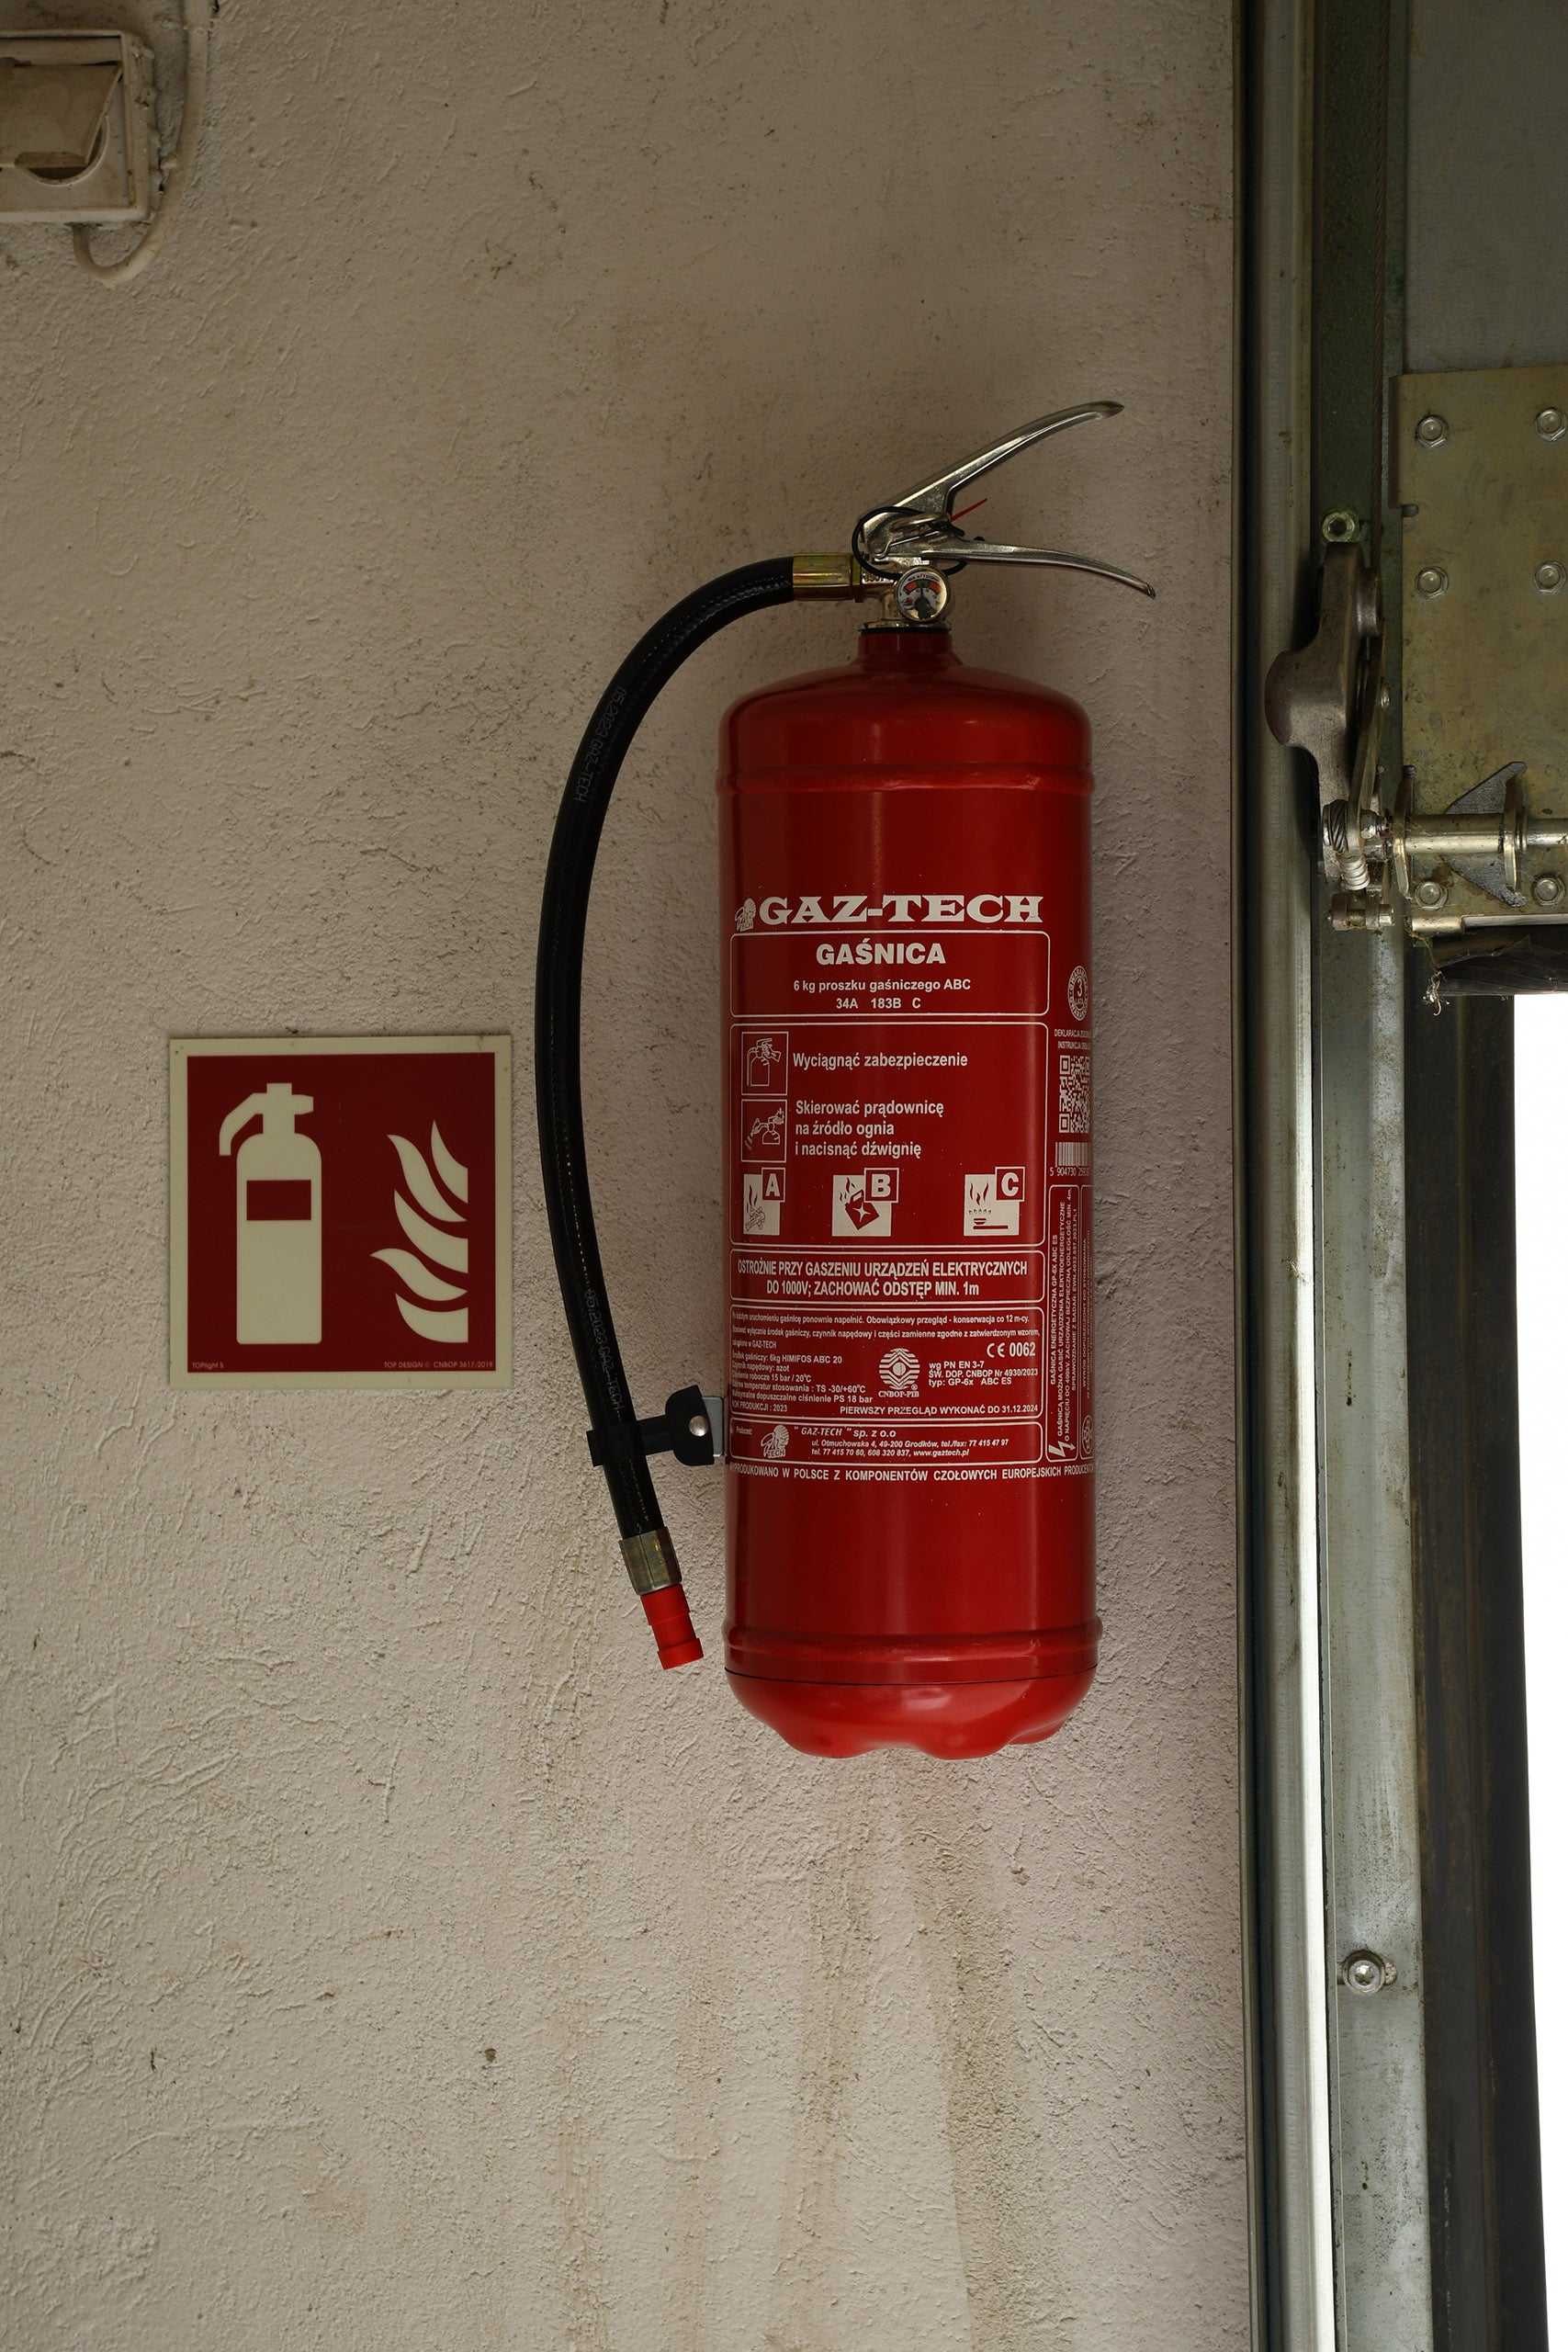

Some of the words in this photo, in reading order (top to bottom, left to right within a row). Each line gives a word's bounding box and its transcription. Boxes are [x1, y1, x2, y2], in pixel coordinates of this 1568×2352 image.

[595, 686, 627, 738] 05.2023
[573, 739, 604, 803] GAZ-TECH
[759, 894, 1043, 924] GAZ-TECH
[816, 938, 946, 966] GAŚNICA
[794, 980, 800, 991] 6
[802, 979, 816, 994] kg
[818, 979, 865, 994] proszku
[869, 978, 941, 994] gaśniczego
[944, 978, 971, 990] ABC
[1077, 978, 1084, 997] 3
[836, 998, 858, 1009] 34A
[871, 998, 901, 1009] 183B
[912, 998, 921, 1009] C
[793, 1052, 861, 1069] Wyciągnąć
[864, 1053, 968, 1069] zabezpieczenie
[795, 1100, 861, 1115] Skierować
[864, 1101, 944, 1118] prądownicę
[795, 1125, 809, 1136] na
[812, 1121, 852, 1136] źródło
[856, 1123, 895, 1138] ognia
[795, 1143, 798, 1156] i
[802, 1141, 858, 1159] nacisnąć
[861, 1141, 921, 1159] dźwignię
[1050, 1167, 1055, 1176] 5
[1056, 1167, 1077, 1176] 904730
[765, 1173, 781, 1196] A
[871, 1173, 891, 1196] B
[1000, 1172, 1020, 1196] C
[738, 1259, 776, 1275] OSTROŻNIE
[778, 1261, 803, 1276] PRZY
[806, 1262, 861, 1277] GASZENIU
[864, 1260, 930, 1281] URZĄDZEŃ
[932, 1261, 1027, 1276] ELEKTRYCZNYCH
[767, 1280, 780, 1295] DO
[782, 1281, 811, 1297] 1000V;
[814, 1278, 879, 1296] ZACHOWAĆ
[883, 1281, 931, 1299] ODSTĘP
[935, 1282, 959, 1295] MIN.
[963, 1282, 979, 1295] 1m
[780, 1314, 801, 1325] gaśnicę
[803, 1316, 833, 1324] ponownie
[834, 1315, 864, 1325] napełnić.
[866, 1315, 915, 1326] Obowiązkowy
[917, 1316, 947, 1326] przegląd
[953, 1316, 995, 1325] konserwacja
[1006, 1315, 1013, 1323] 12
[812, 1329, 836, 1339] czynnik
[838, 1329, 872, 1339] napędowy
[878, 1329, 900, 1340] części
[937, 1329, 963, 1339] zgodne
[969, 1329, 1016, 1339] zatwierdzonym
[752, 1340, 777, 1349] GAZ-TECH
[1009, 1341, 1036, 1357] 0062
[384, 1361, 397, 1369] TOP
[399, 1361, 423, 1369] DESIGN
[433, 1361, 457, 1369] CNBOP
[458, 1361, 493, 1369] 3617/2019
[770, 1354, 781, 1363] 6kg
[782, 1354, 811, 1363] HIMIFOS
[813, 1355, 830, 1363] ABC
[832, 1355, 842, 1364] 20
[192, 1362, 219, 1370] TOPlight
[776, 1364, 790, 1373] azot
[929, 1363, 942, 1371] wg
[944, 1361, 955, 1369] PN
[780, 1374, 791, 1382] bar
[929, 1368, 943, 1378] ŚW.
[946, 1370, 964, 1378] DOP.
[965, 1369, 993, 1378] CNBOP
[1004, 1367, 1038, 1376] 4930/2023
[773, 1384, 809, 1393] stosowania
[816, 1385, 826, 1393] TS
[929, 1379, 945, 1388] typ:
[948, 1378, 974, 1386] GP-6x
[981, 1377, 998, 1385] ABC
[1001, 1377, 1011, 1385] ES
[878, 1390, 919, 1398] CNBOP-PIB
[1065, 1385, 1070, 1396] DO
[756, 1391, 796, 1402] dopuszczalne
[798, 1393, 831, 1402] ciśnienie
[833, 1395, 844, 1403] PS
[847, 1395, 856, 1403] 18
[859, 1395, 873, 1403] bar
[773, 1403, 788, 1412] 2023
[840, 1406, 886, 1414] PIERWSZY
[888, 1406, 937, 1417] PRZEGLĄD
[940, 1404, 986, 1414] WYKONAĆ
[987, 1405, 999, 1414] DO
[1002, 1404, 1038, 1413] 31.12.2024
[801, 1427, 841, 1437] GAZ-TECH
[853, 1430, 868, 1439] sp.
[812, 1439, 820, 1447] ul.
[821, 1439, 869, 1448] Otmuchowska
[878, 1440, 903, 1448] 49-200
[905, 1439, 940, 1449] Grodków,
[812, 1448, 821, 1456] tel.
[823, 1448, 830, 1456] 77
[856, 1449, 866, 1458] 60,
[868, 1449, 880, 1457] 608
[882, 1449, 895, 1457] 320
[913, 1448, 969, 1458] www.gaztech.pl
[782, 1467, 790, 1478] W
[794, 1468, 829, 1480] POLSCE
[833, 1470, 840, 1480] Z
[846, 1469, 928, 1481] KOMPONENTÓW
[933, 1469, 997, 1481] CZOŁOWYCH
[1002, 1466, 1061, 1479] EUROPEJSKICH
